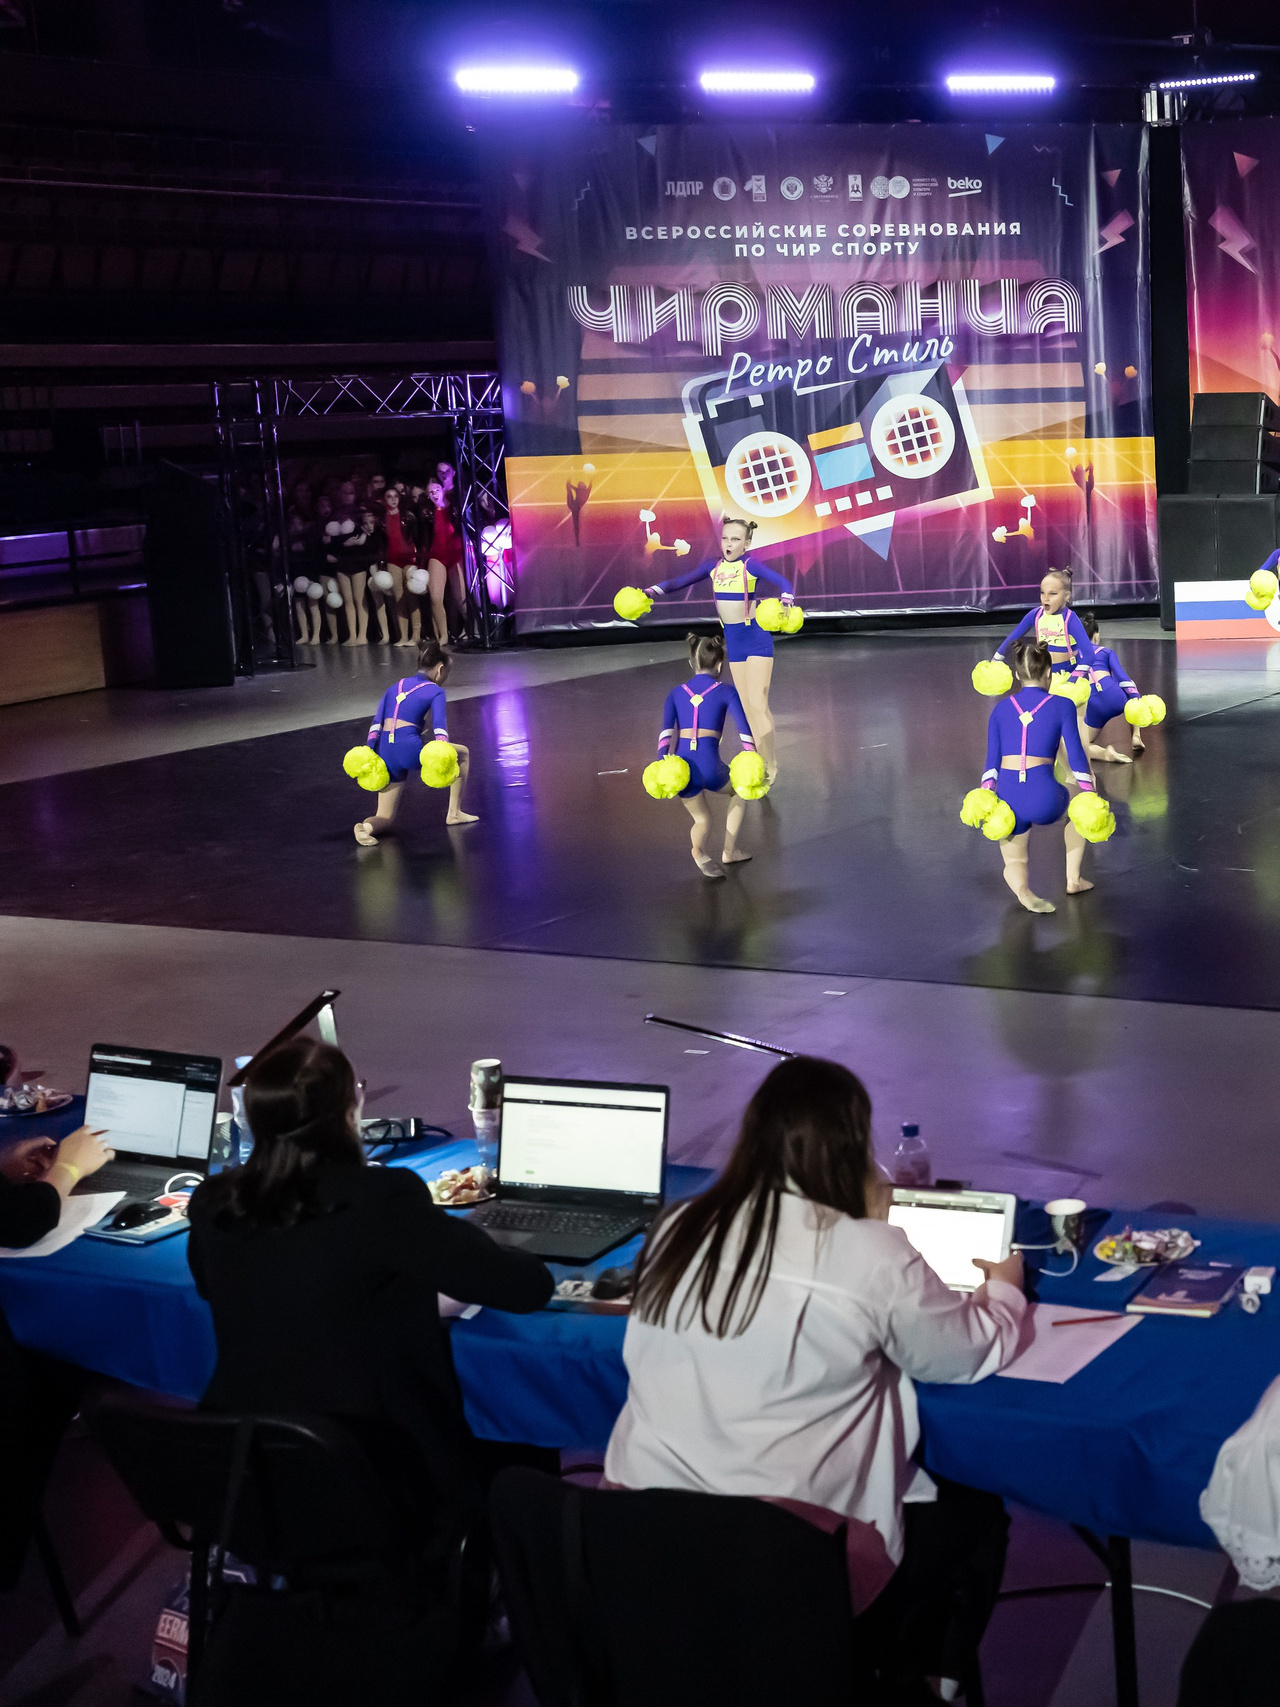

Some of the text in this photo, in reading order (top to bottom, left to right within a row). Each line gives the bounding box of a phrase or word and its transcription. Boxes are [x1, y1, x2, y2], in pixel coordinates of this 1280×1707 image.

[665, 181, 704, 198] ЛДПР
[947, 177, 982, 190] beko
[626, 221, 1021, 240] ВСЕРОССИЙСКИЕ СОРЕВНОВАНИЯ
[735, 241, 920, 258] ПО ЧИР СПОРТУ
[725, 333, 954, 394] Ретро Стиль
